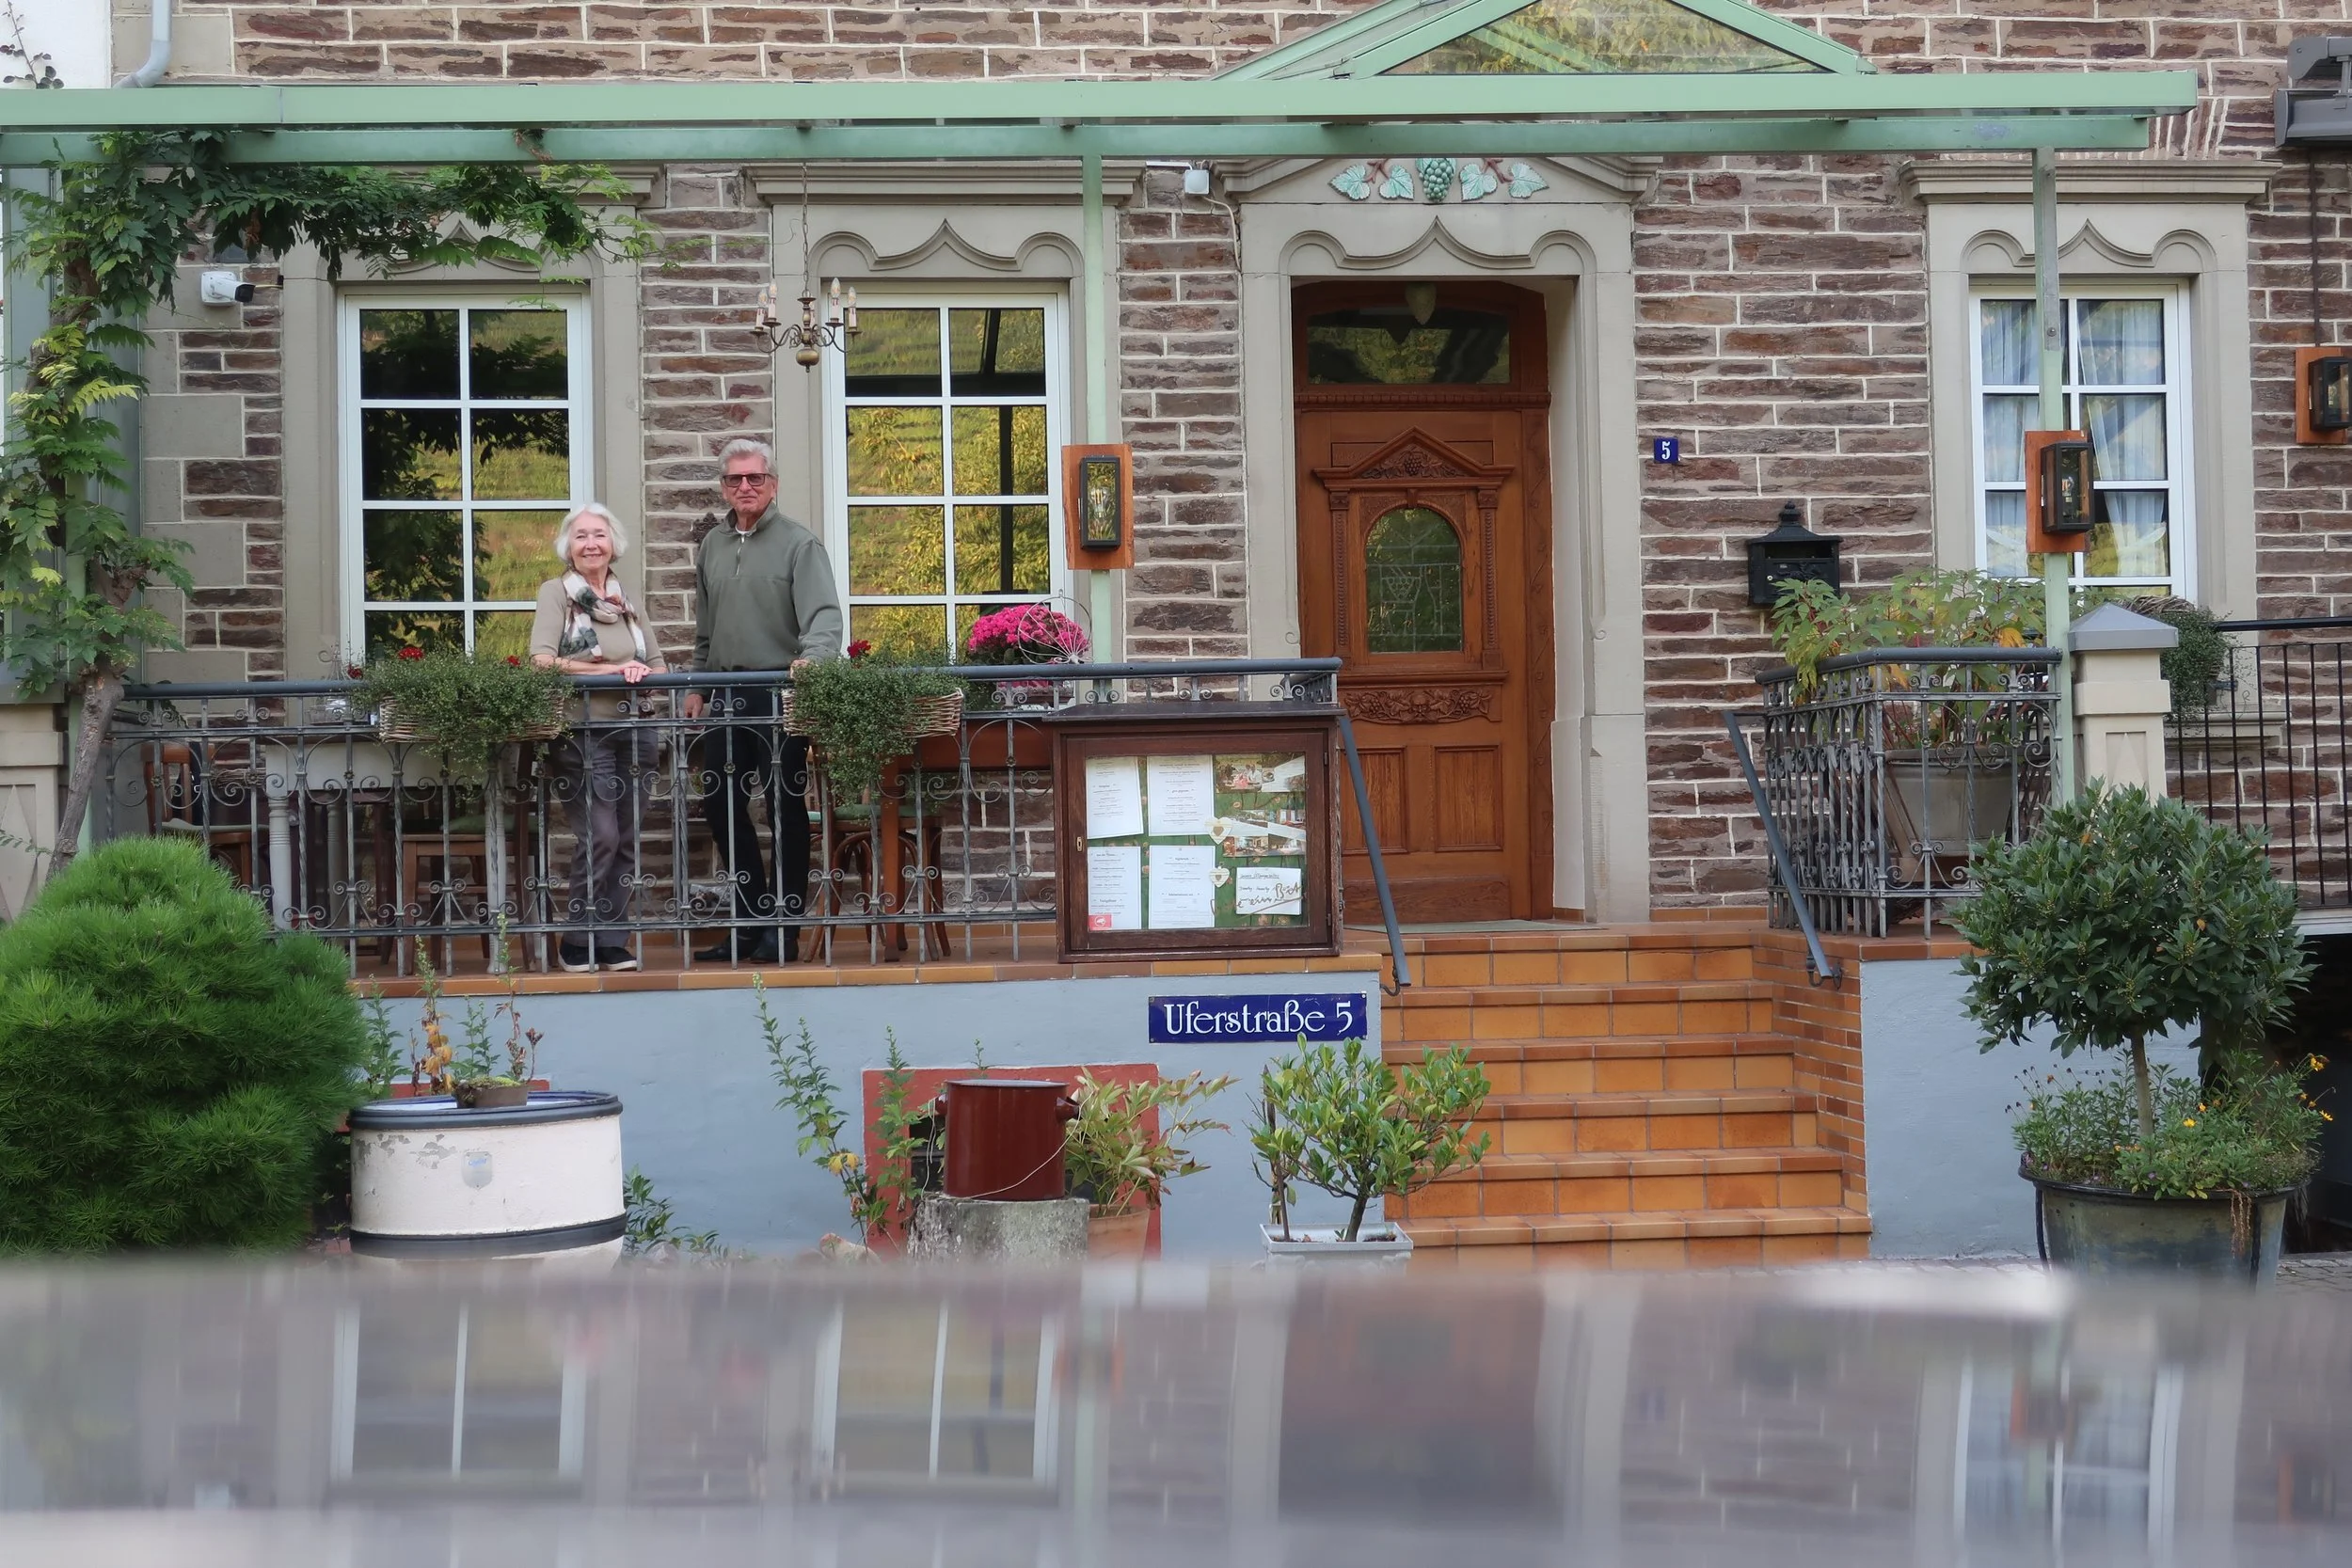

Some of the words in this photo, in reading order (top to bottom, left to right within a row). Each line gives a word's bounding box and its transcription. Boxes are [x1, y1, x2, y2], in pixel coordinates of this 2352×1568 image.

[1661, 441, 1671, 460] 5
[1163, 999, 1326, 1035] Uferstraße
[1336, 1000, 1353, 1036] 5
